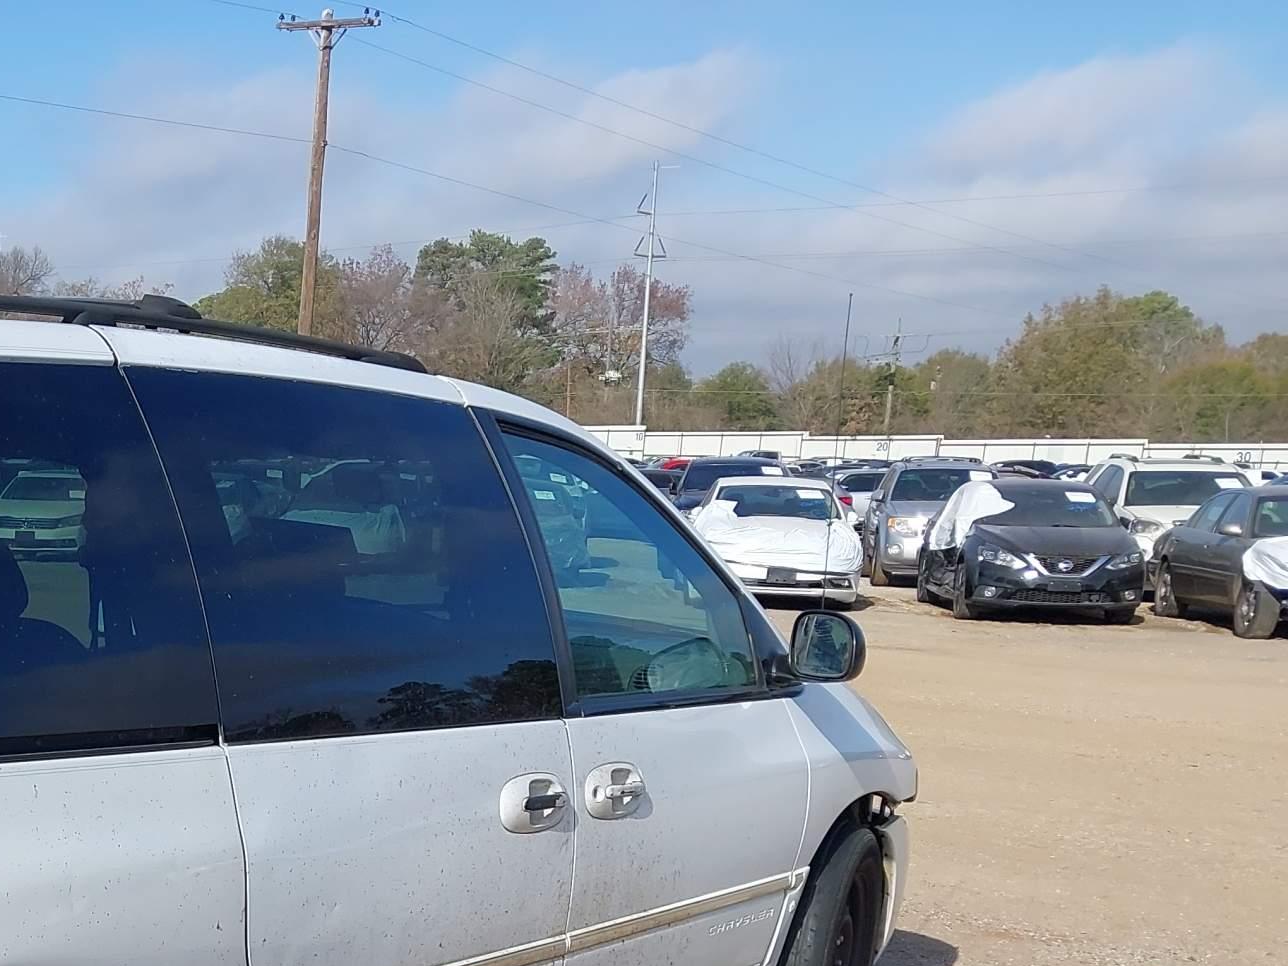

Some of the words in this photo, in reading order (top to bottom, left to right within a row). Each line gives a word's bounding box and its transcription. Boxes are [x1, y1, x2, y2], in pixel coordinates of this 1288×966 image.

[635, 432, 644, 441] 10
[876, 441, 889, 452] 20
[1235, 451, 1252, 463] 30
[708, 908, 774, 936] CHRYSLER
